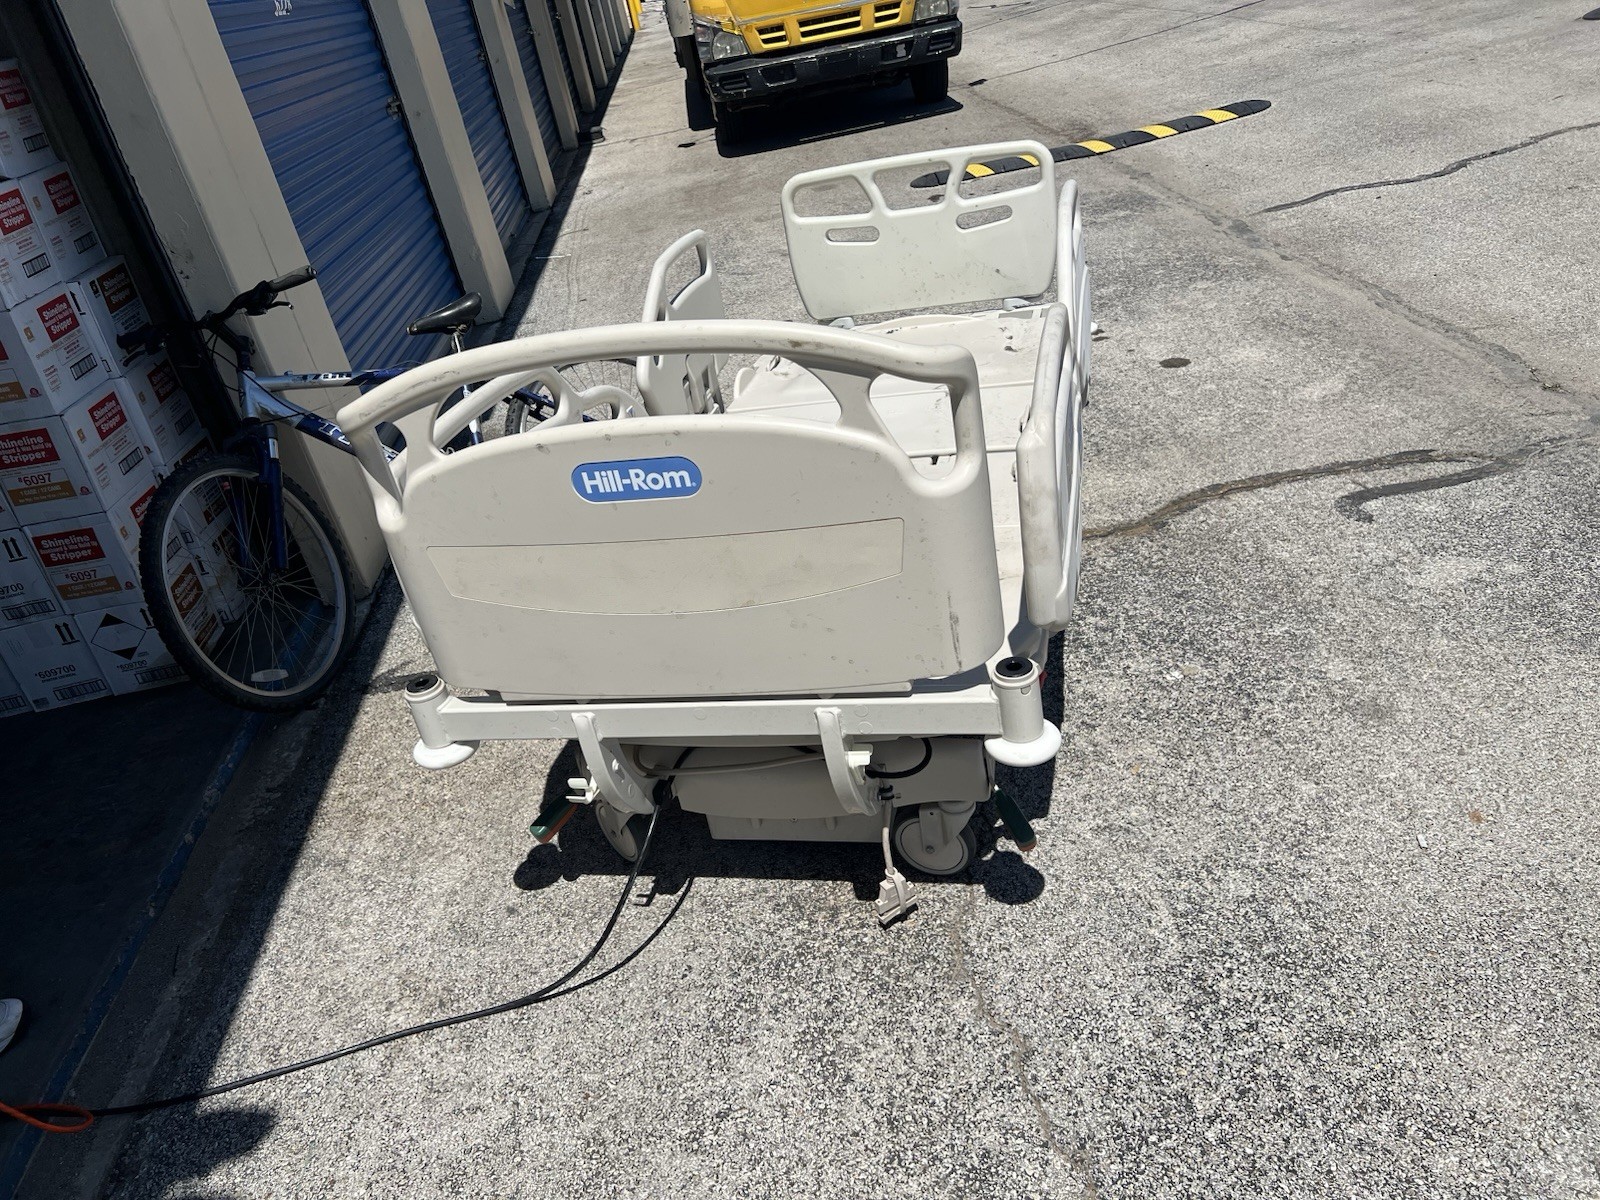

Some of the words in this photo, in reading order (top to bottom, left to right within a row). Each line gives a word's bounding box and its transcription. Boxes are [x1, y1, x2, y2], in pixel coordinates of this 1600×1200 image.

[3, 213, 26, 228] Stripper
[42, 302, 68, 320] Shineline
[50, 317, 73, 334] Stripper
[2, 450, 46, 465] Stripper
[581, 468, 695, 494] Hill-Rom
[41, 534, 90, 549] Shineline
[50, 549, 92, 562] Stripper
